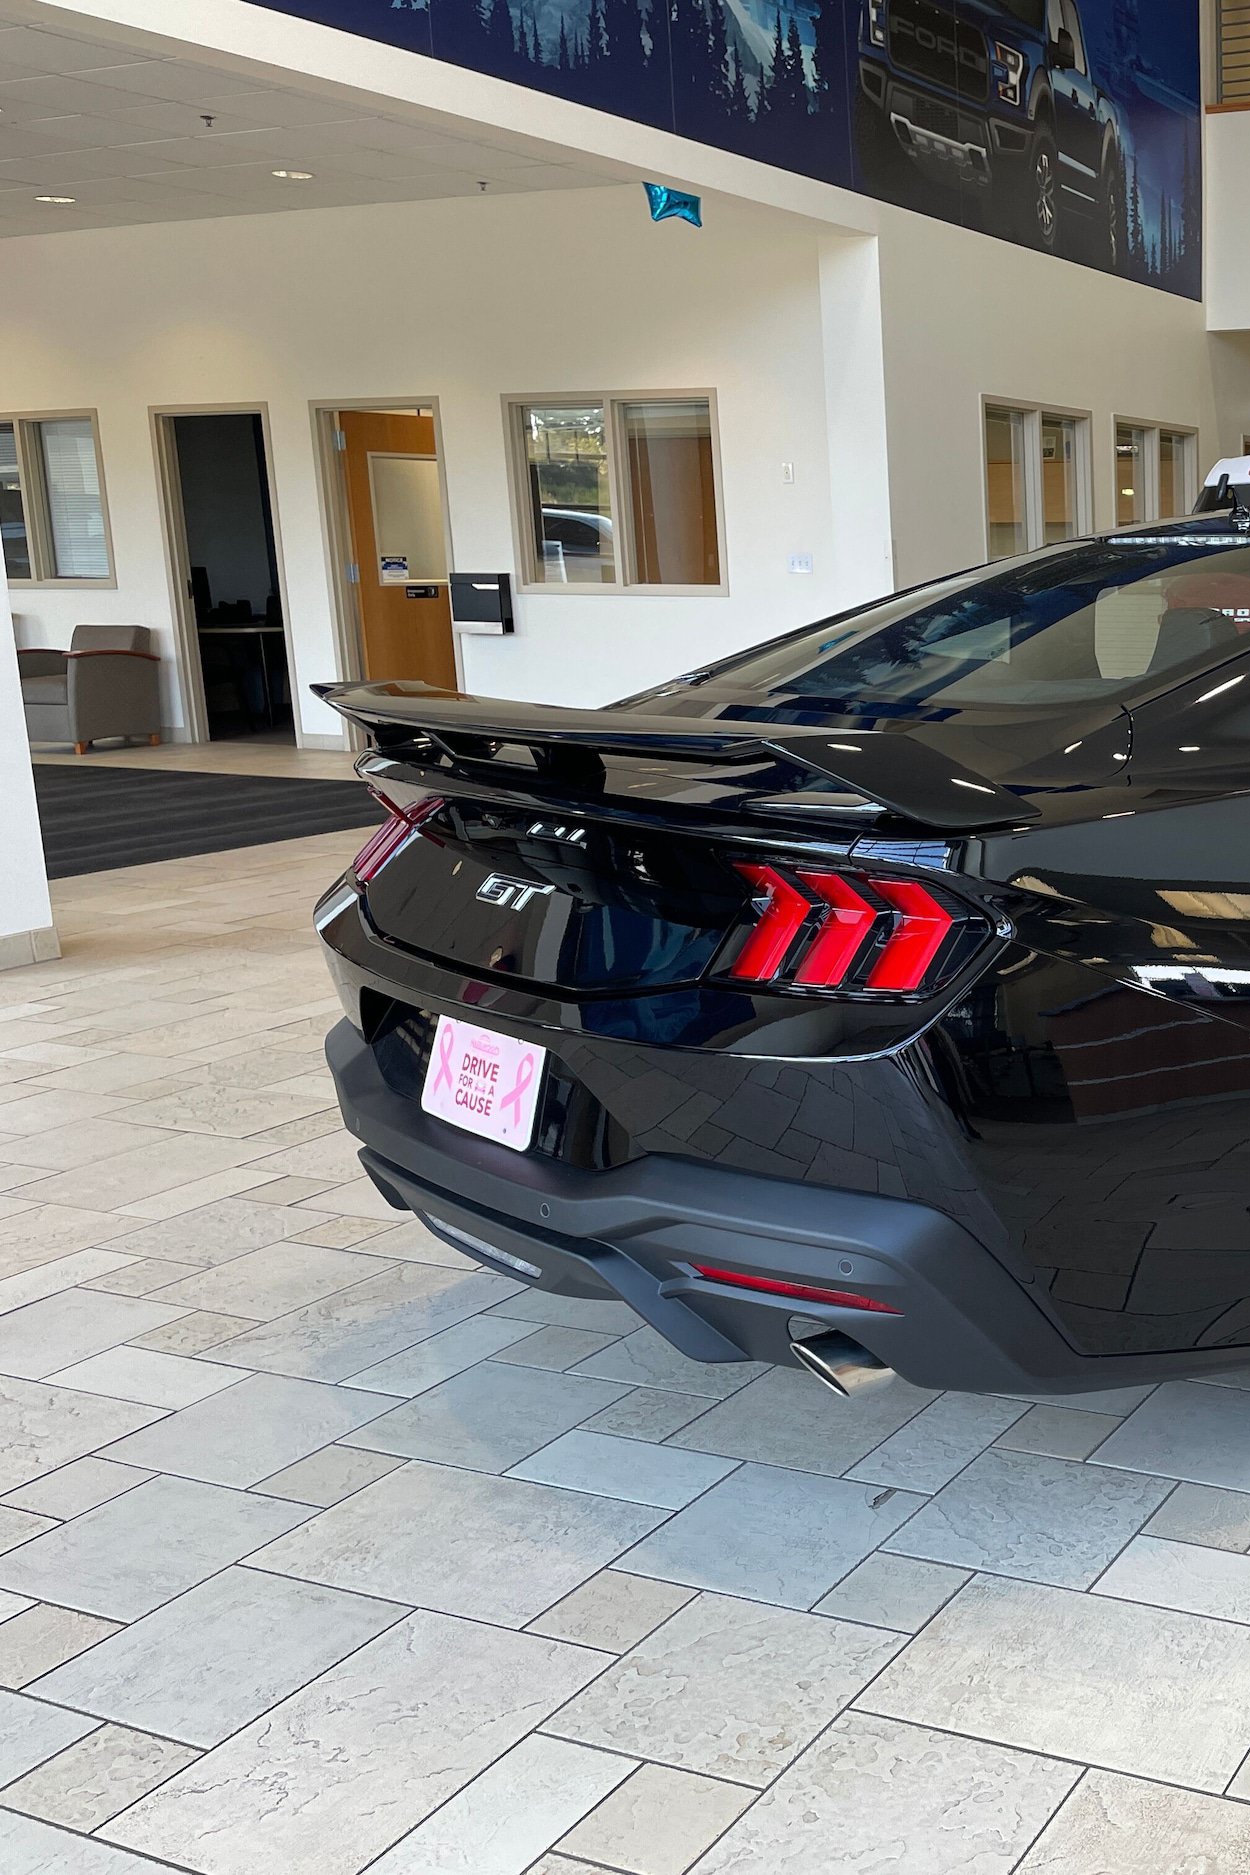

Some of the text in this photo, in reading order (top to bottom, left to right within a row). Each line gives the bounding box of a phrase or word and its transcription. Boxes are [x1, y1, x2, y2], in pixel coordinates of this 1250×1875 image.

[889, 13, 988, 74] FORD
[475, 872, 557, 912] GT
[462, 1053, 500, 1082] DRIVE
[459, 1073, 495, 1097] FOR A
[455, 1088, 493, 1117] CAUSE
